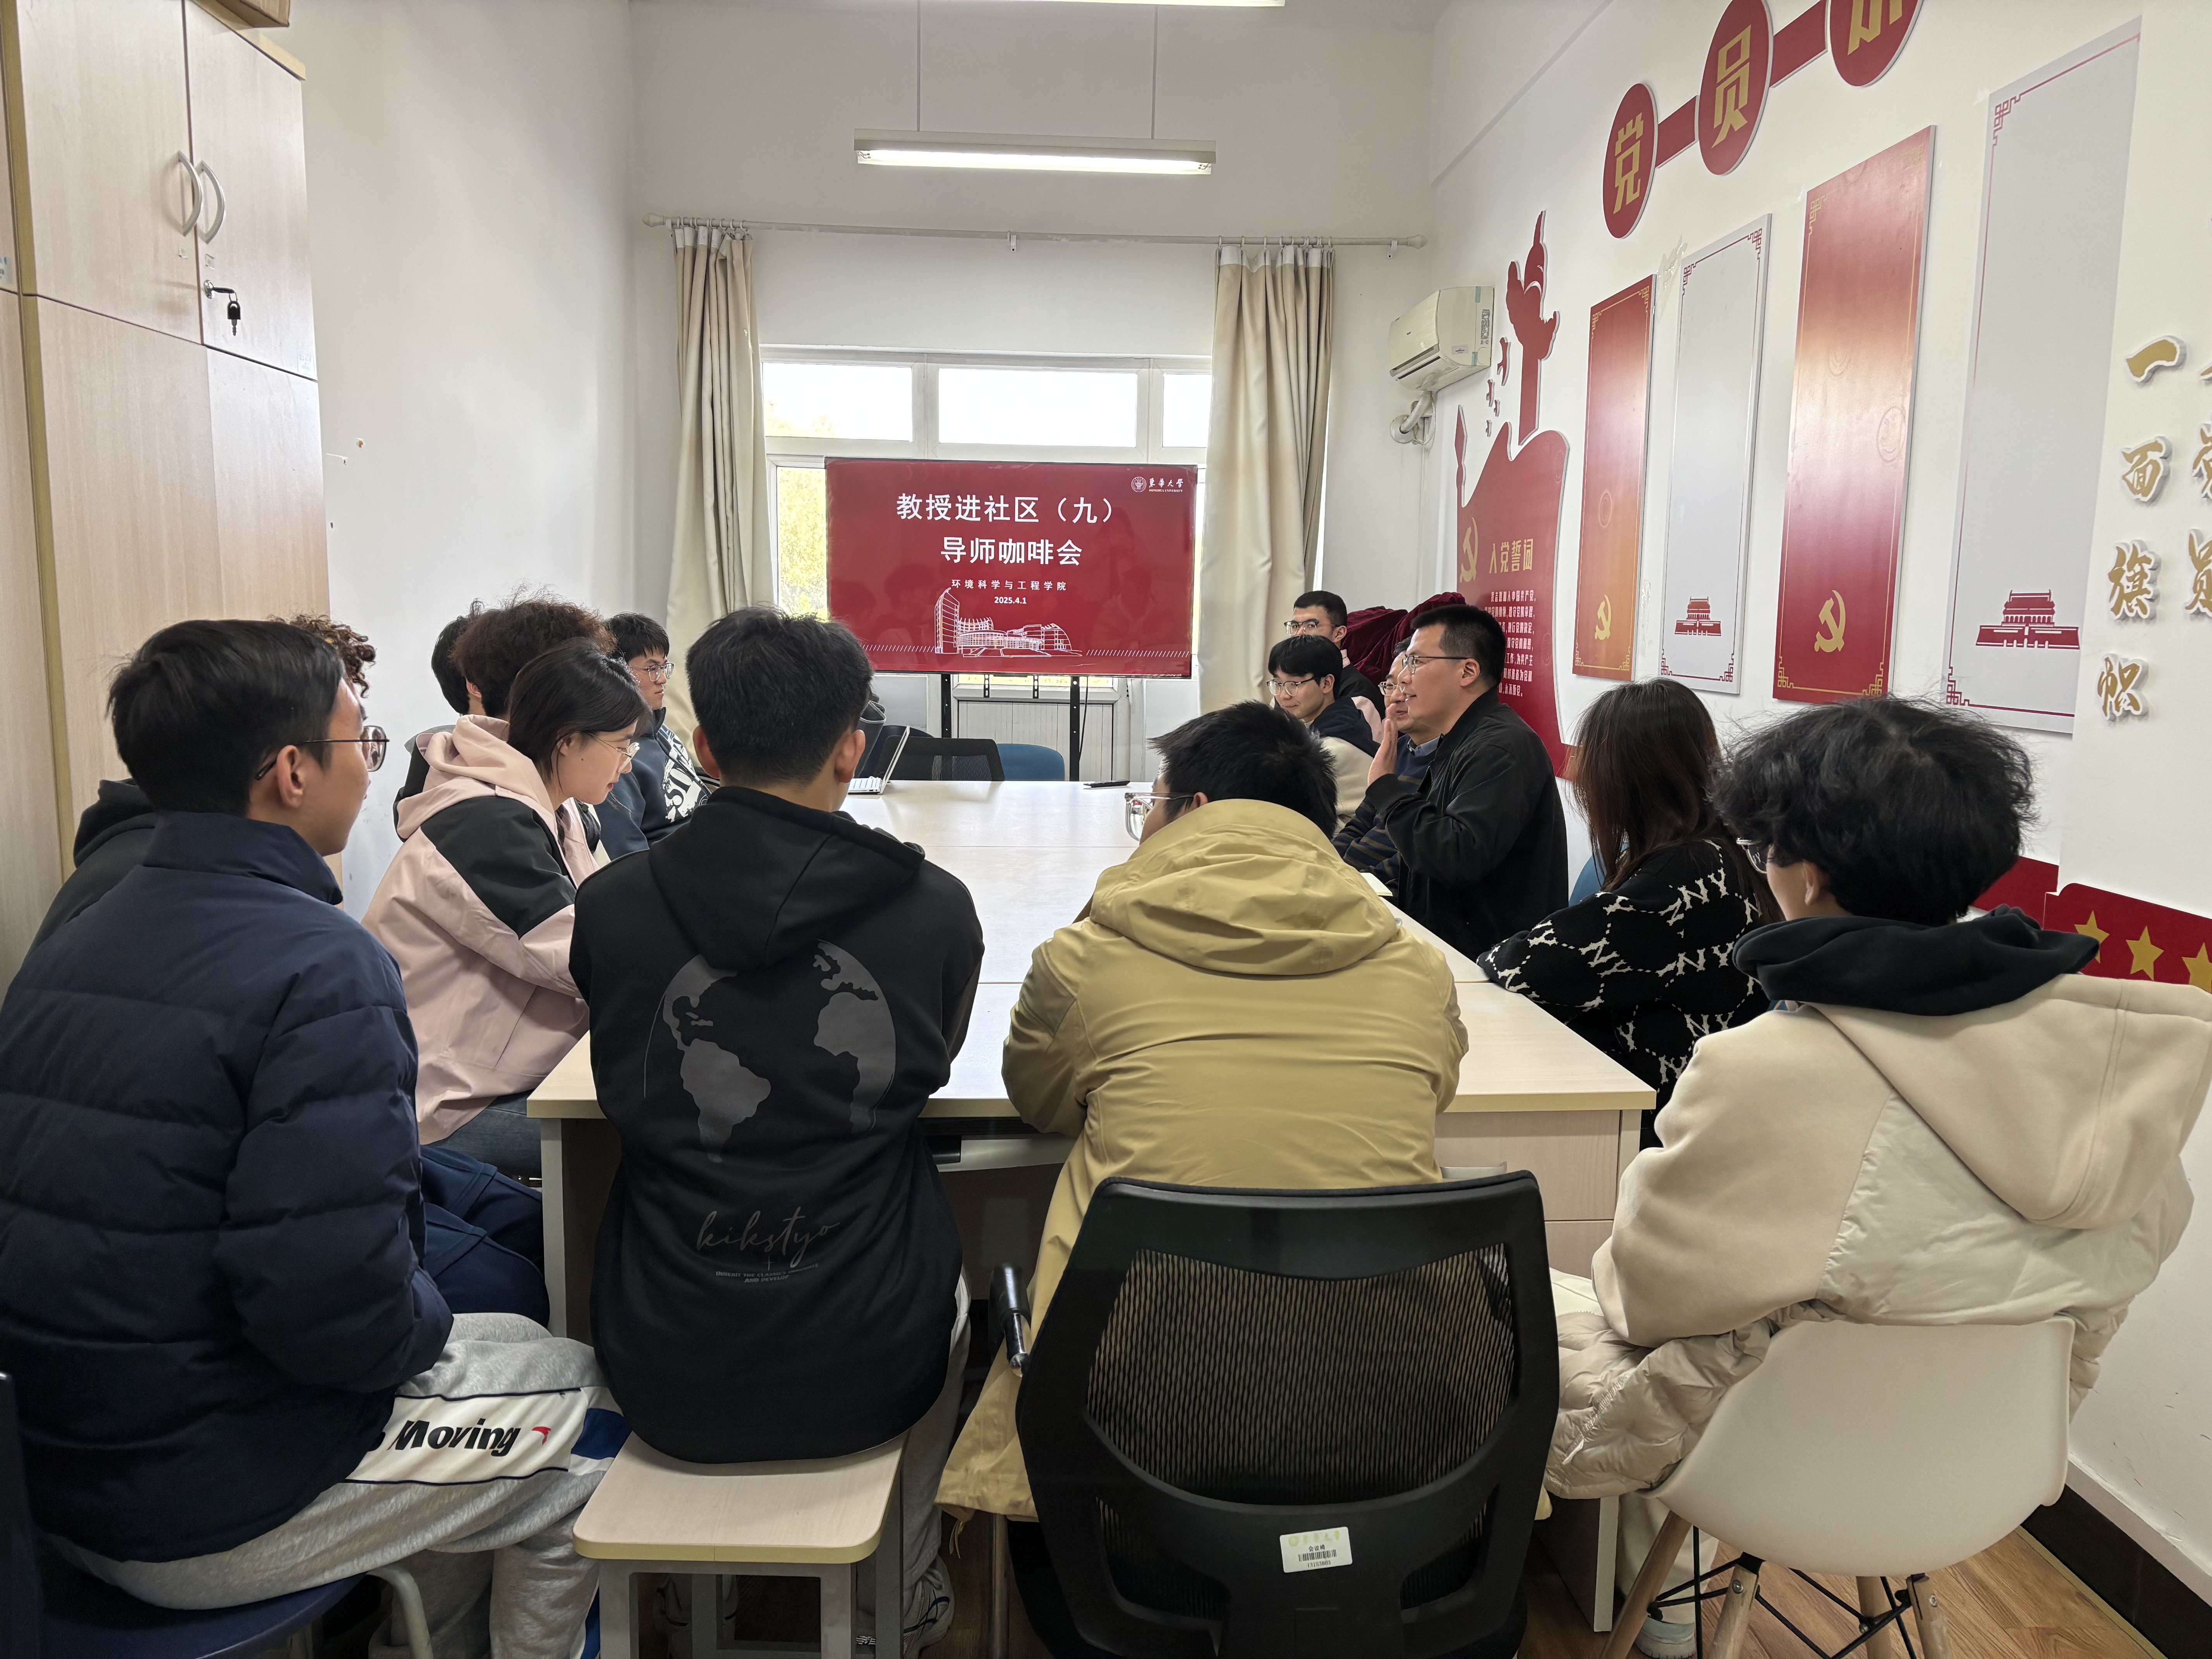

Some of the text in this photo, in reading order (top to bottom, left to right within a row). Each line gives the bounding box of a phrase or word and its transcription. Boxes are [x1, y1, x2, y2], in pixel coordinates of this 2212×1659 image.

[896, 493, 1112, 524] 教授进社区（九）
[2097, 339, 2176, 717] 一面旗帜
[941, 537, 1083, 566] 导师咖啡会
[1489, 538, 1534, 574] 入党誓词
[951, 579, 1067, 591] 环境科学与工程学院
[994, 596, 1027, 605] 2025.4.1
[1677, 867, 1729, 911] NY
[1676, 941, 1734, 975] NY
[387, 1418, 521, 1457] Moving
